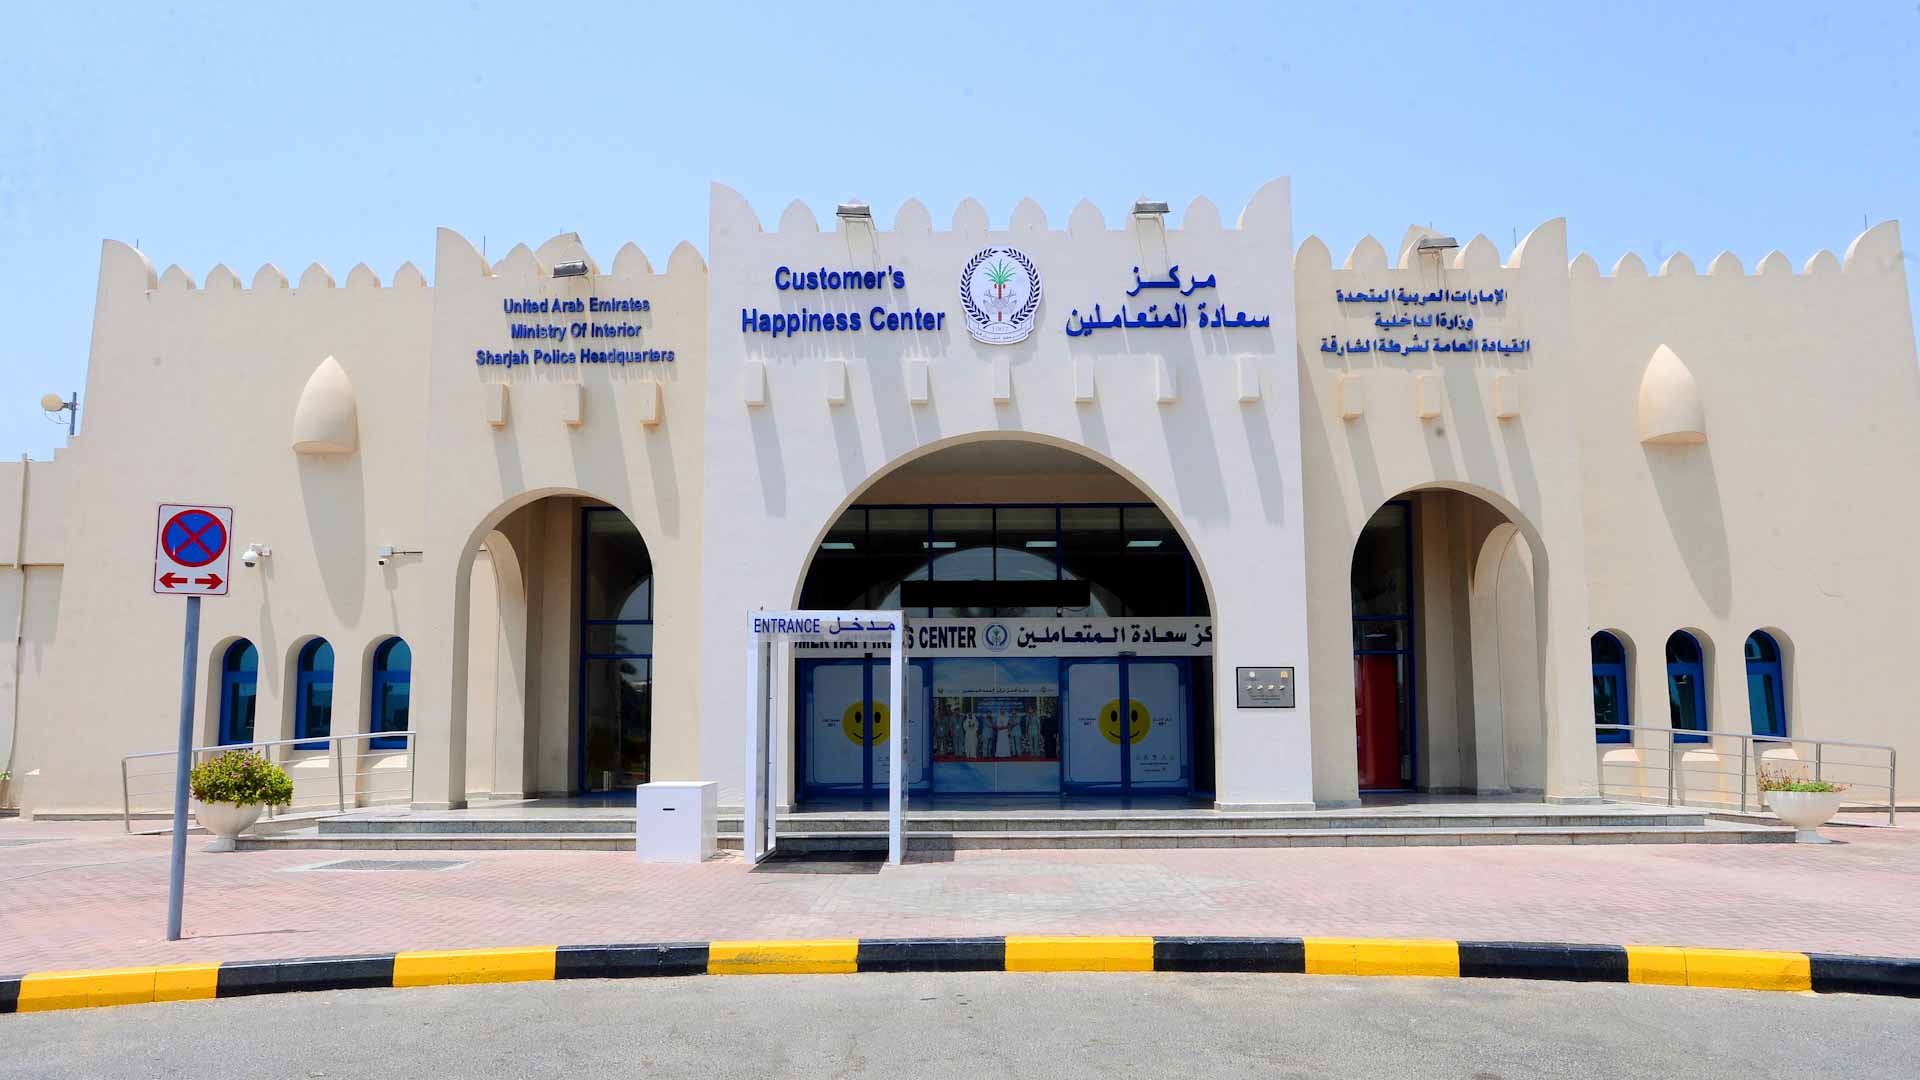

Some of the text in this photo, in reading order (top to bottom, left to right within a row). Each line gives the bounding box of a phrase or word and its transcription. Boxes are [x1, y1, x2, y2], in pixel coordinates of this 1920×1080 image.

[774, 264, 905, 290] Customer's
[1125, 264, 1217, 297] مركز
[504, 297, 649, 313] United Arab Emirates
[1336, 289, 1395, 303] المتحدة
[1397, 288, 1449, 306] العربية
[741, 305, 945, 338] Happiness Center
[1064, 302, 1271, 336] سعادة المتعاملين
[1375, 312, 1473, 331] وزارة الداخلية
[512, 322, 642, 342] Ministry Of Interior
[1321, 335, 1531, 356] القيادة العامة لشرطة الشارقة
[476, 349, 674, 368] Sharjah Police Headquarters
[754, 618, 820, 634] ENTRANCE
[829, 616, 895, 635] مدخل
[1131, 624, 1187, 643] سعادة
[919, 626, 976, 649] CENTER
[1017, 624, 1125, 649] المتعاملين
